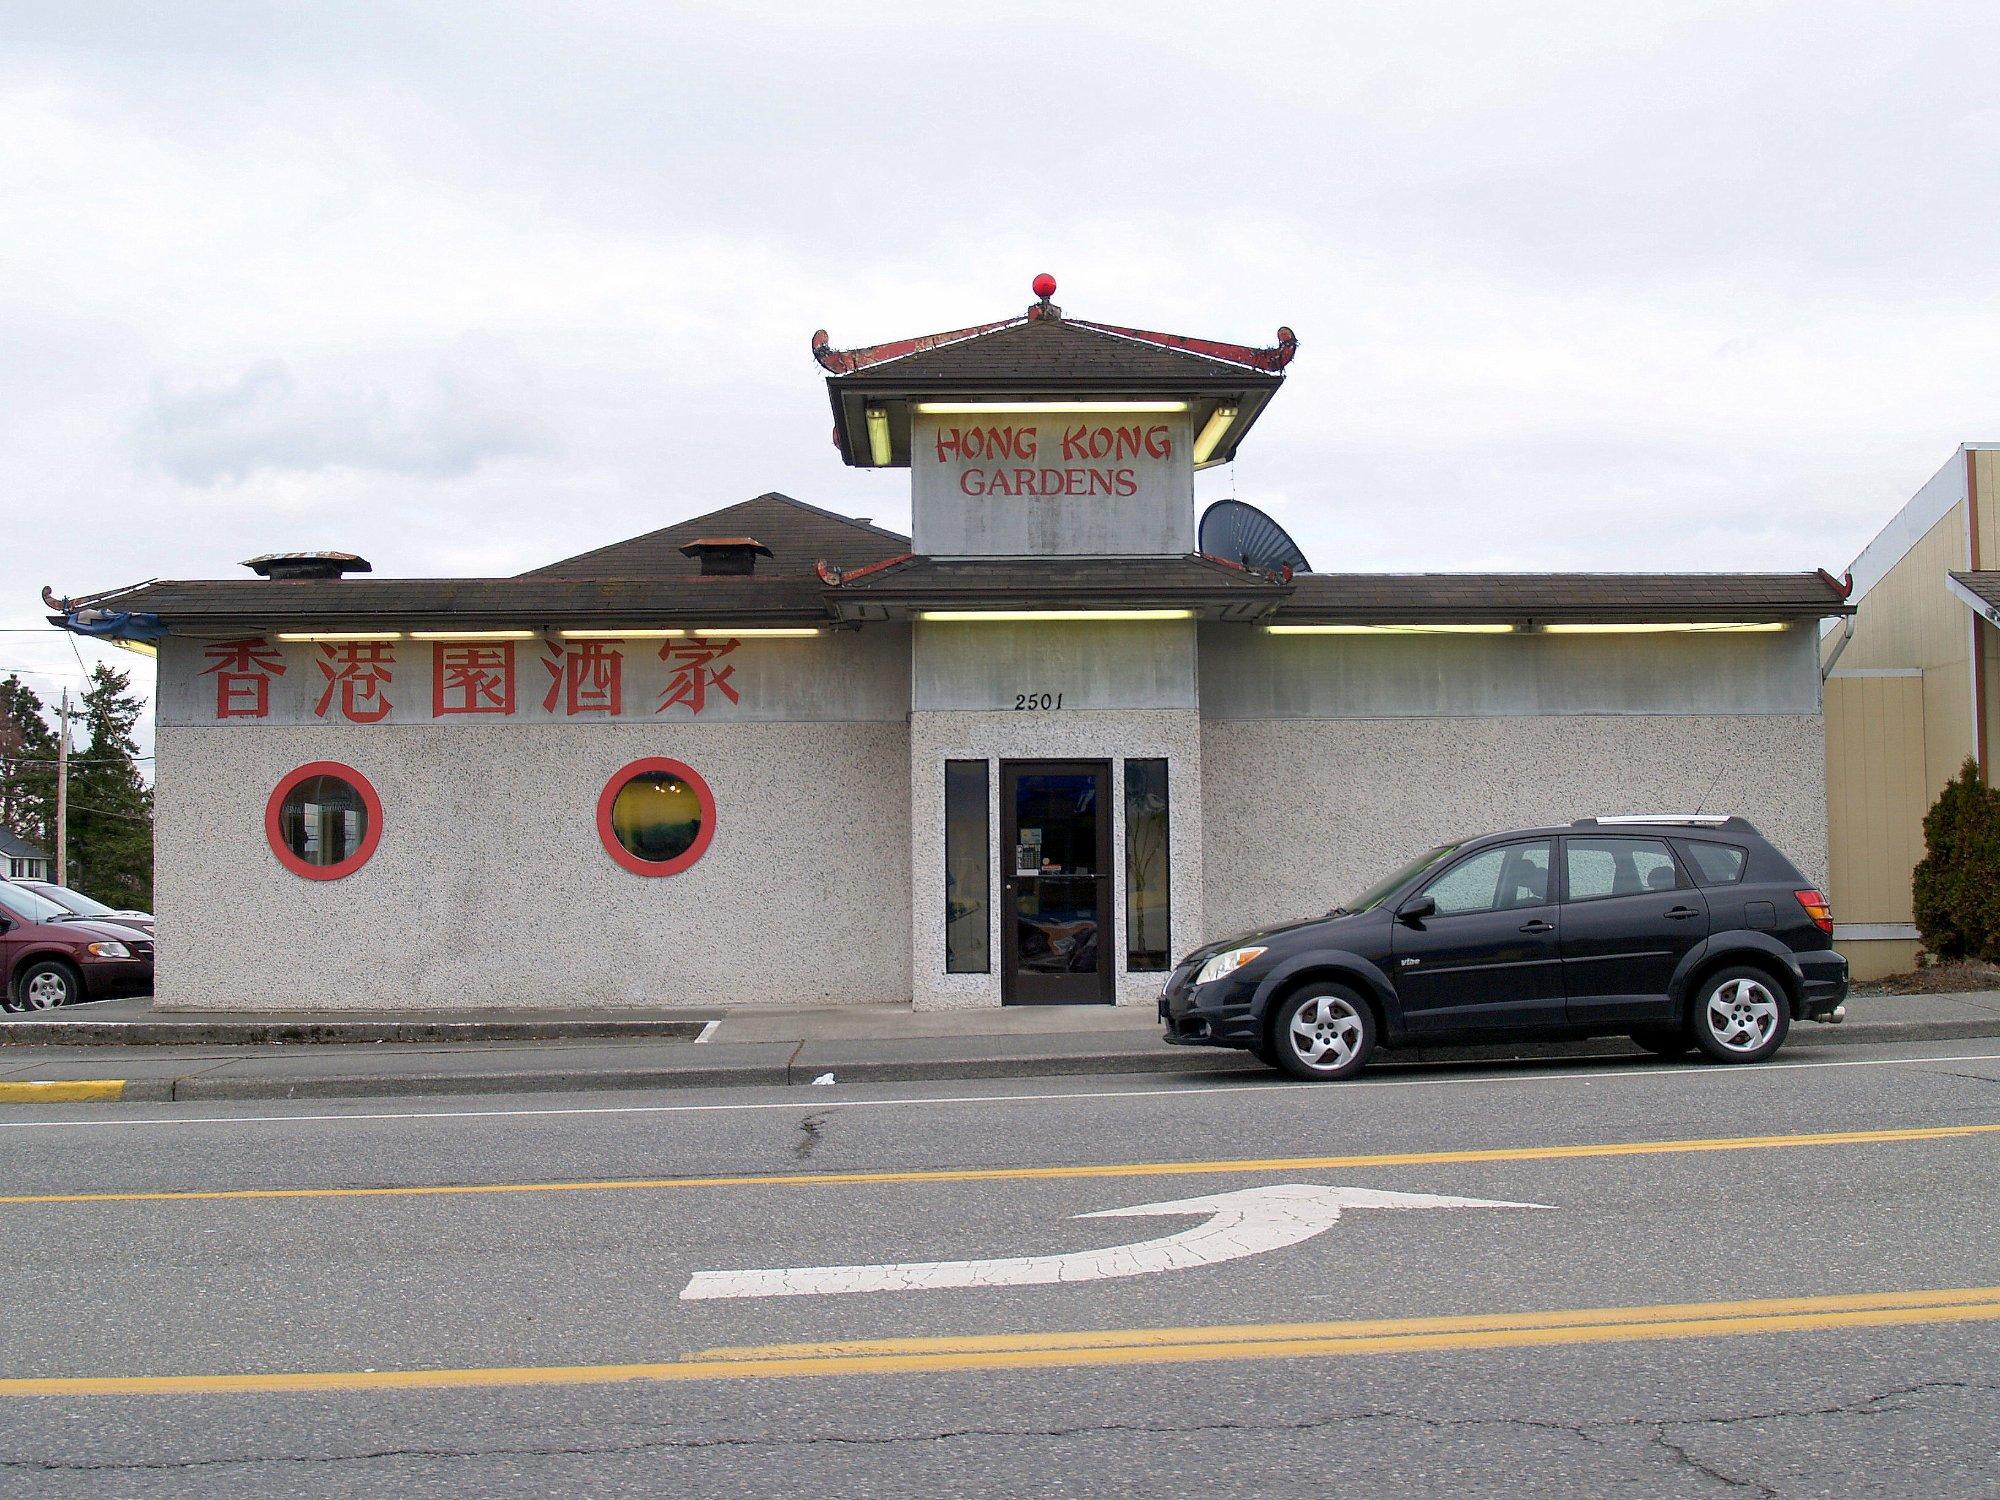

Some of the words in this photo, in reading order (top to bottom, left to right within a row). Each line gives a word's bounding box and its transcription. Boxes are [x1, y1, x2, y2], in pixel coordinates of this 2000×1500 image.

[935, 425, 1037, 462] HONG
[1060, 424, 1171, 461] KONG
[960, 468, 1138, 497] GARDENS
[198, 637, 742, 723] 香港園酒家
[1015, 693, 1063, 710] 2501
